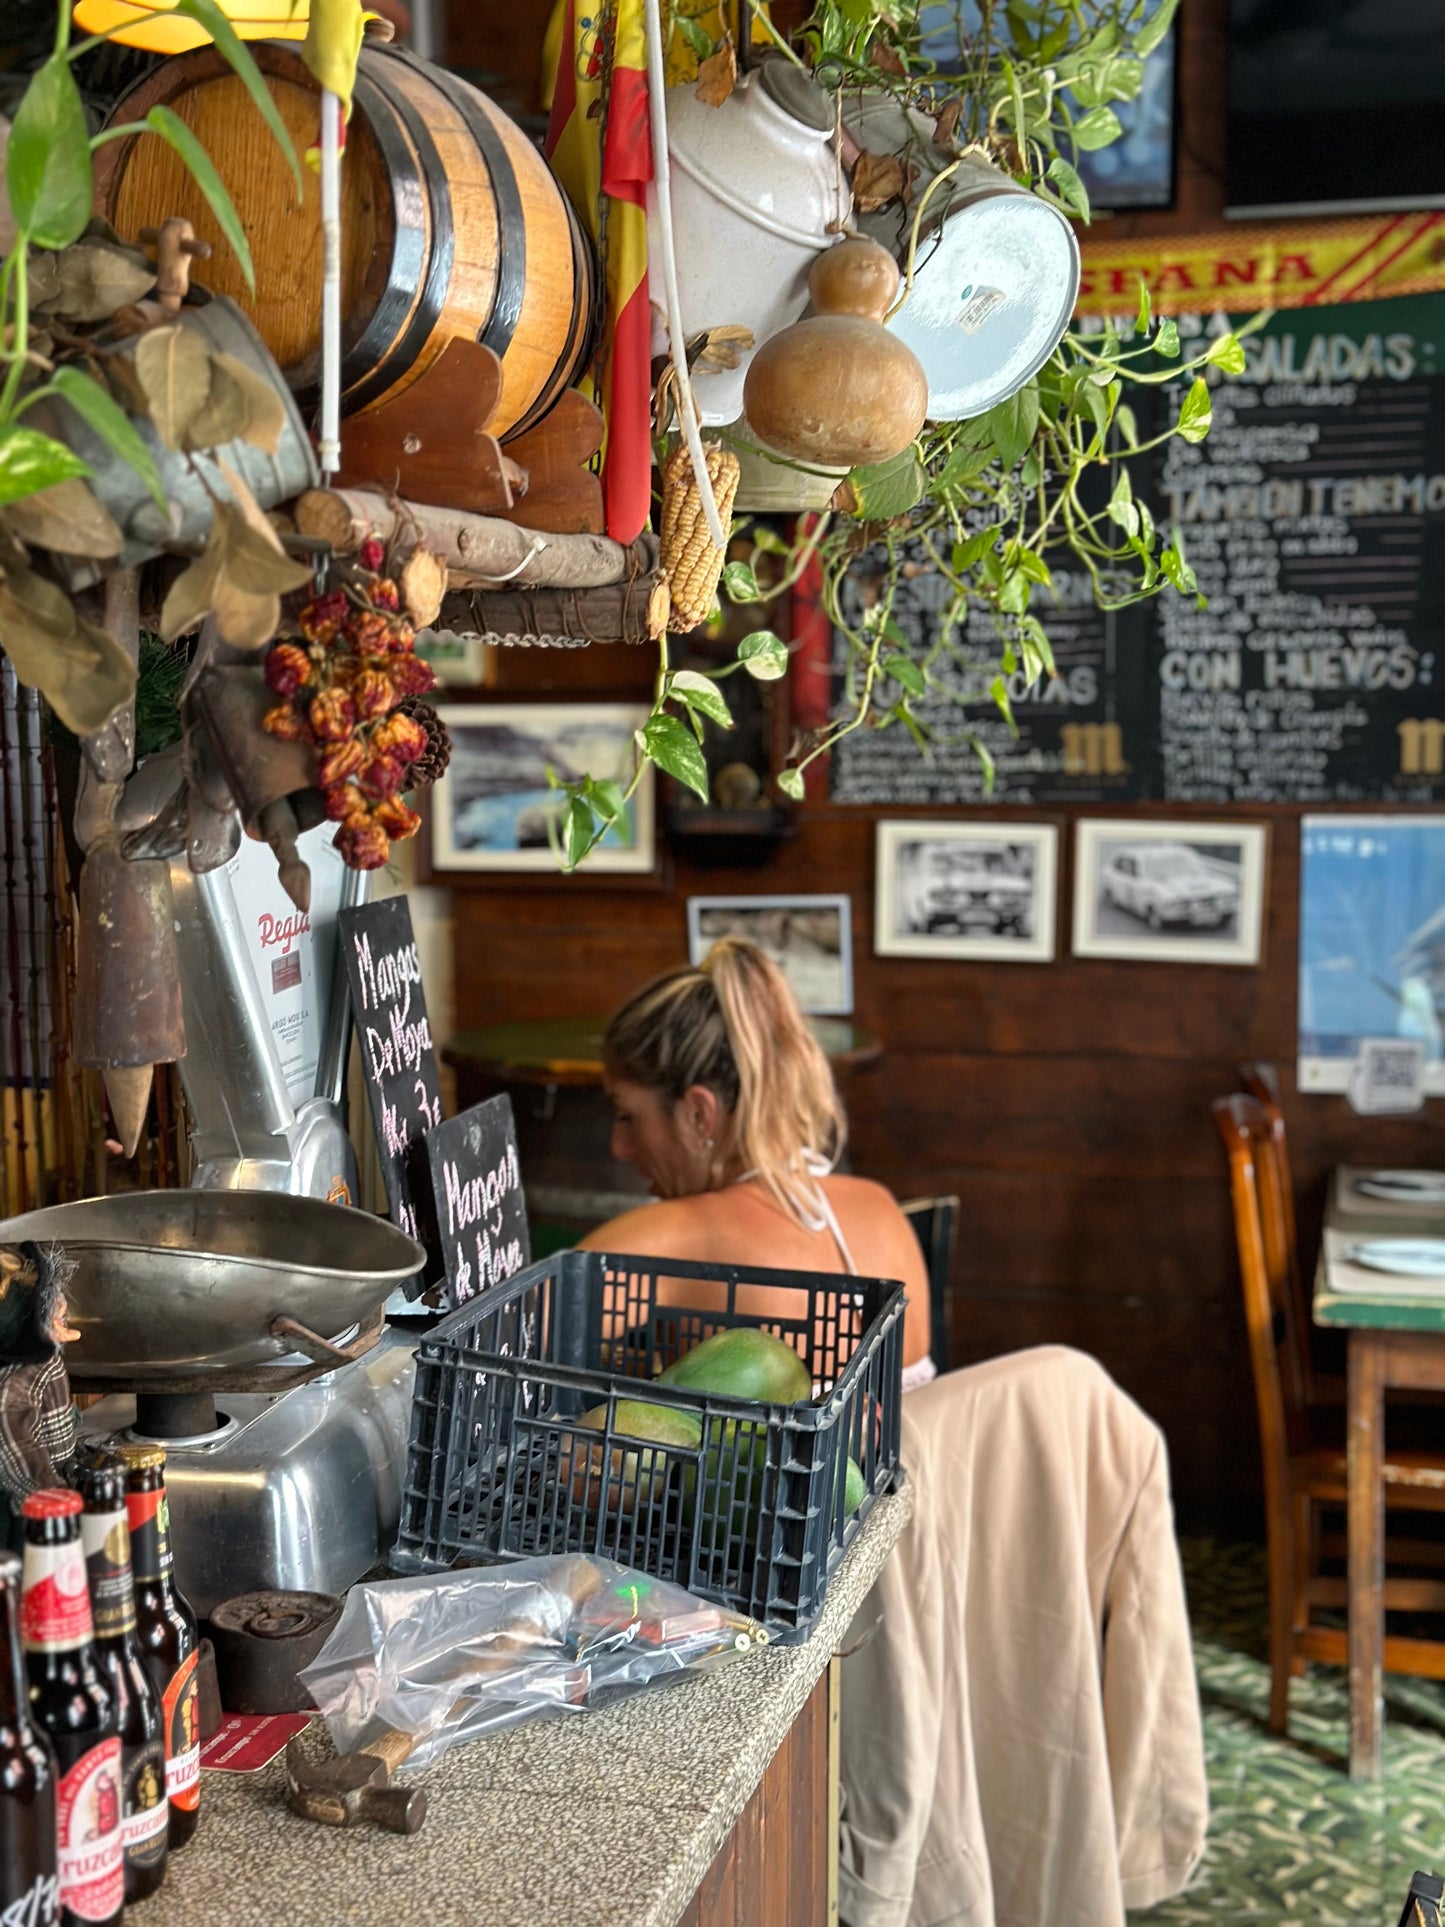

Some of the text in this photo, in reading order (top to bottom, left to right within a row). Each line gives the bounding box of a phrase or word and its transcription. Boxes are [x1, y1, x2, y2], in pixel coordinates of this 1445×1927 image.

[1307, 474, 1445, 516] TENEMO
[1159, 645, 1435, 691] CON HUEVOS:
[258, 906, 311, 954] Regia
[354, 931, 421, 1029] Mangos
[165, 1759, 200, 1790] ruzc
